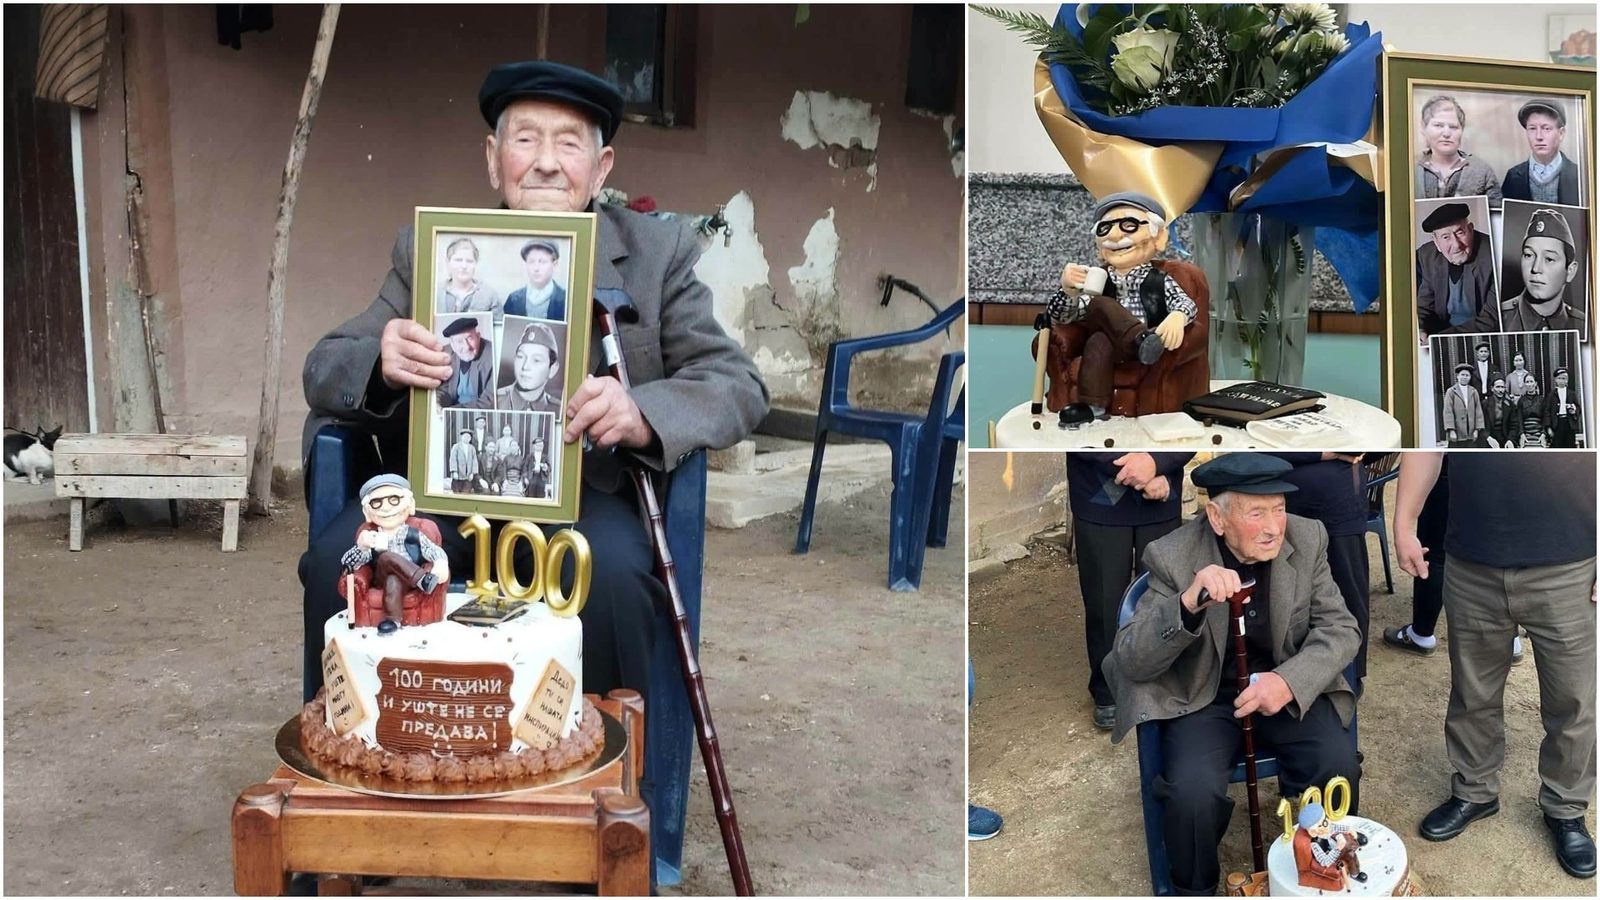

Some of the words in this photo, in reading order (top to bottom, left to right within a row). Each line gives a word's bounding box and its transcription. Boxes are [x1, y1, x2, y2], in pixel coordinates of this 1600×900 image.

[457, 514, 592, 618] 100
[389, 667, 423, 689] 100
[432, 678, 502, 697] ГОДИНИ
[383, 694, 395, 709] И
[401, 700, 448, 718] УШТЕ
[455, 704, 475, 719] НЕ
[483, 704, 506, 719] СЕ
[401, 720, 498, 749] ПРЕДАВА!
